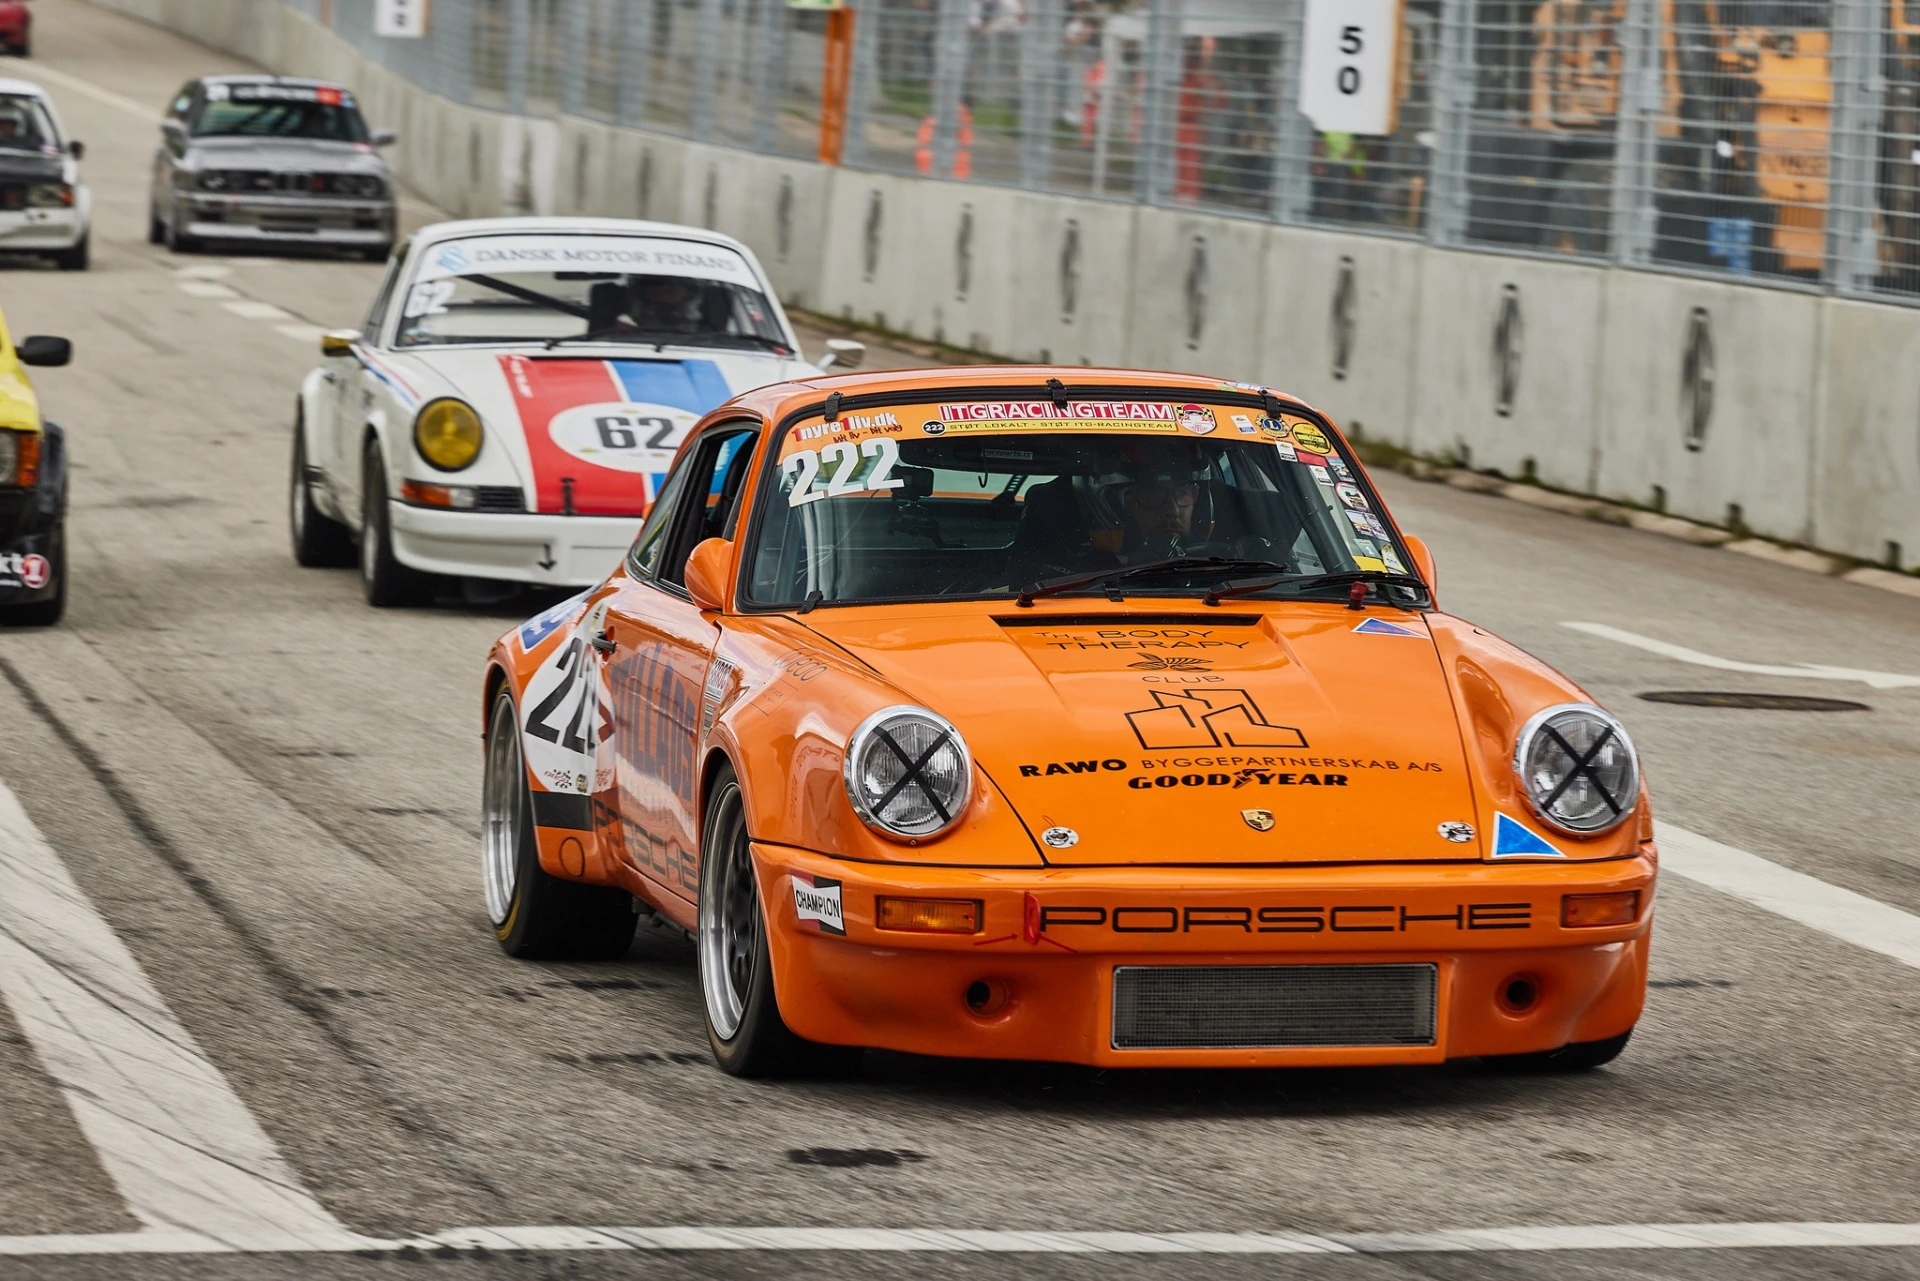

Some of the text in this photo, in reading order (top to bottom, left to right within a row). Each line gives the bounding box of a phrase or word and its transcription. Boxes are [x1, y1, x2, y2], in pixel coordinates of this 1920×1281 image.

[474, 249, 555, 263] DANSK
[563, 249, 647, 264] MOTOR
[654, 252, 738, 272] FINANS
[404, 281, 457, 319] 62
[942, 403, 1173, 420] ITGRACINGTEAM
[595, 416, 680, 451] 62
[791, 412, 899, 442] 1nyre1liv.dk
[924, 424, 944, 432] 222
[1075, 421, 1173, 429] ITG-RACINGTEAM
[782, 436, 905, 508] 222
[1035, 630, 1214, 641] THE BODY
[1046, 640, 1250, 651] THERAPY
[1142, 675, 1225, 684] CLUB
[1018, 757, 1444, 778] RAWO BYGGEPARTNERSKAB A/S
[1128, 770, 1349, 790] GOODYEAR
[795, 889, 841, 919] CHAMPION
[1039, 902, 1533, 934] PORSCHE
